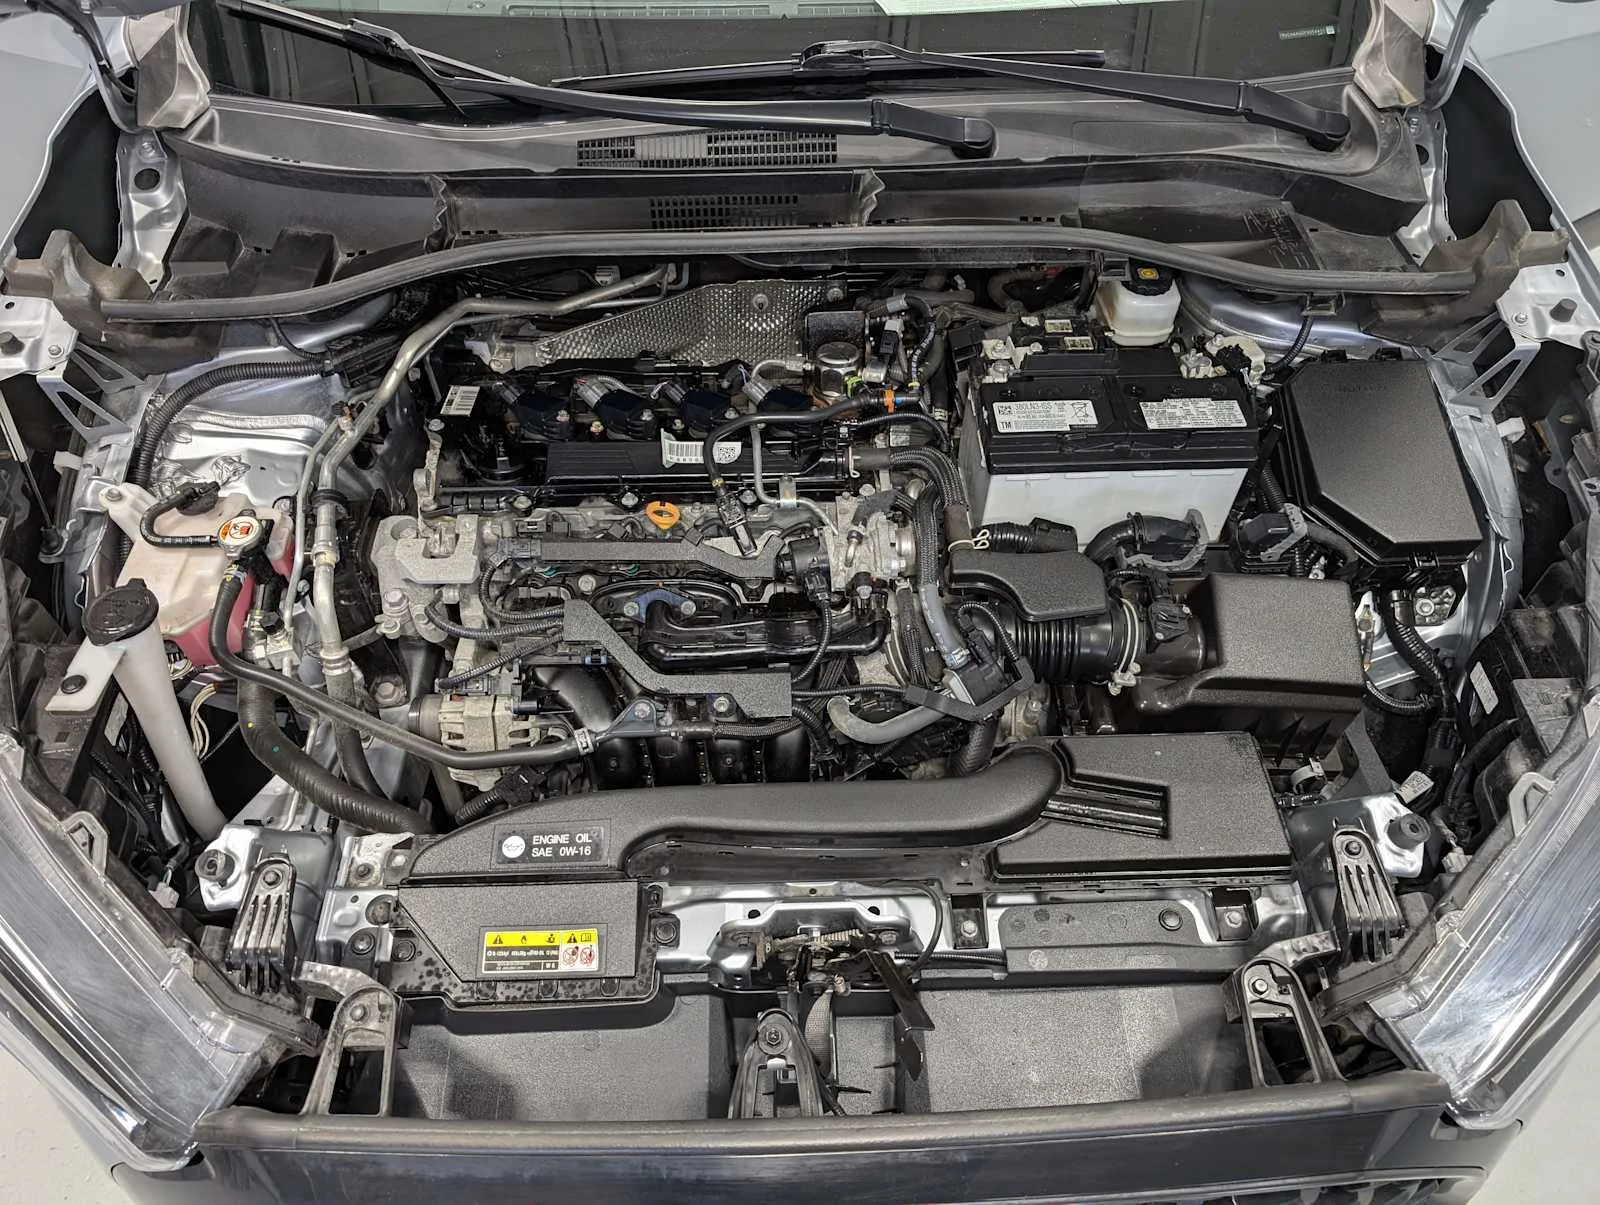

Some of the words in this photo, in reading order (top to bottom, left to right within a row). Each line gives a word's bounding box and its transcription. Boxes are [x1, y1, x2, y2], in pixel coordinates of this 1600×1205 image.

[1001, 421, 1012, 429] TM
[532, 834, 570, 844] ENGINE
[575, 833, 593, 843] OIL
[531, 847, 553, 857] SAE
[559, 846, 592, 856] 0W-16
